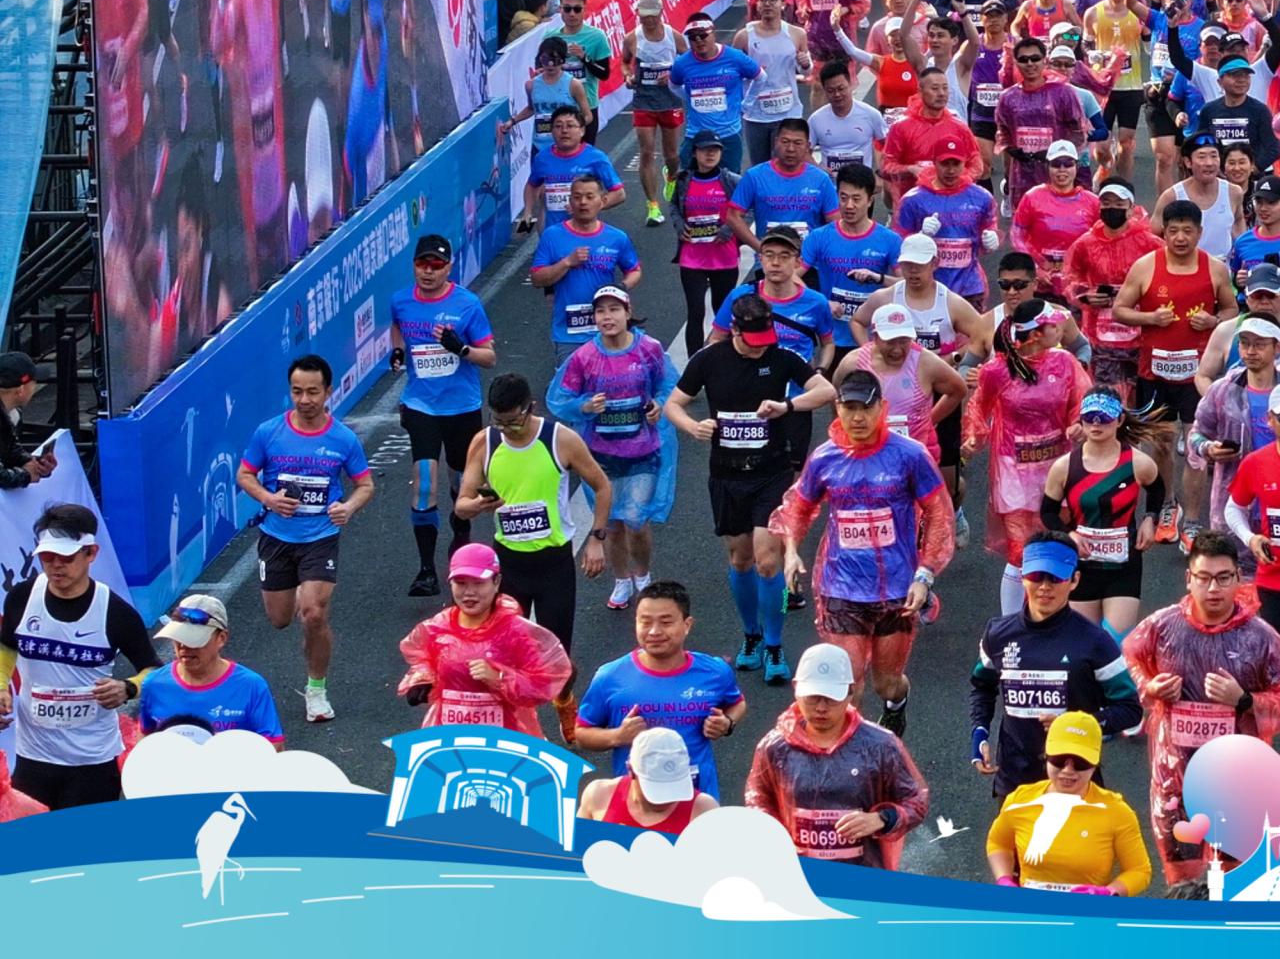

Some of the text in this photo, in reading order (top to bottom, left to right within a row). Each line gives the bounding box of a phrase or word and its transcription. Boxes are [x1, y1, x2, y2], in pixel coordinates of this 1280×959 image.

[416, 354, 456, 370] B03084
[1156, 362, 1195, 374] B02983
[722, 426, 765, 440] B07588
[502, 515, 545, 533] B05492
[843, 524, 890, 541] B04174
[1007, 689, 1061, 706] B07166
[37, 701, 91, 719] B04127
[446, 708, 497, 724] B04511
[1175, 718, 1229, 736] B02875
